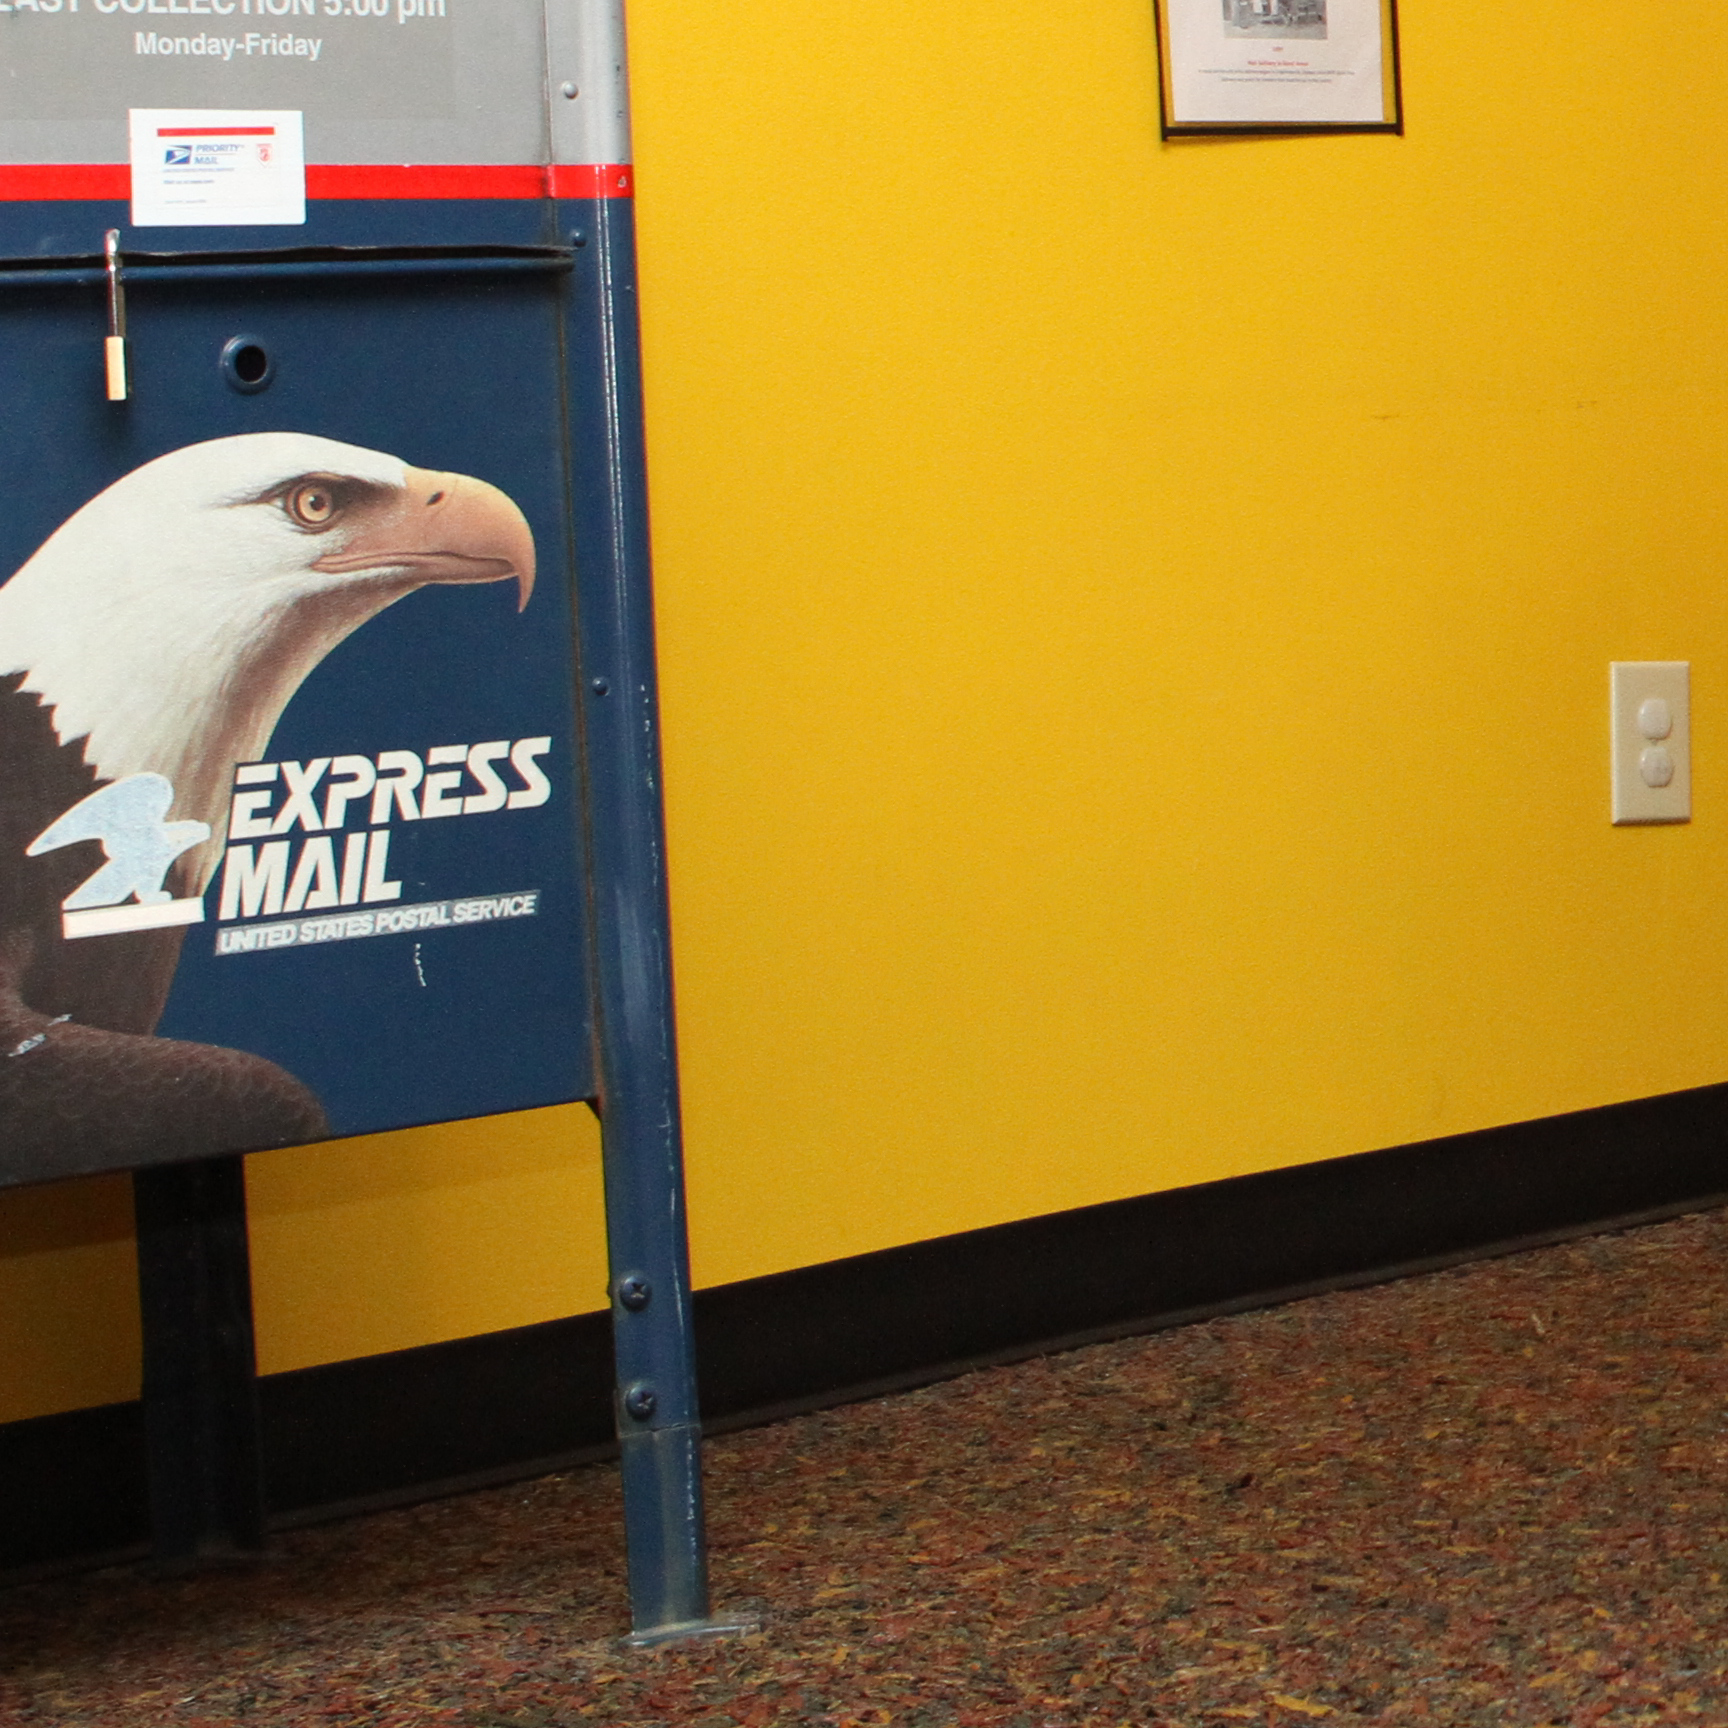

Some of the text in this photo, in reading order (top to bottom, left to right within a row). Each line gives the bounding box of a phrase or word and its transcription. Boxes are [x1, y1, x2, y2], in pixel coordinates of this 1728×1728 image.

[134, 31, 322, 60] Monday-Friday
[194, 156, 218, 165] MAIL
[196, 143, 240, 153] PRIORITY
[229, 736, 552, 840] EXPRESS
[218, 829, 402, 921] MAIL
[219, 894, 538, 954] UNITED STATES POSTAL SERVICE
